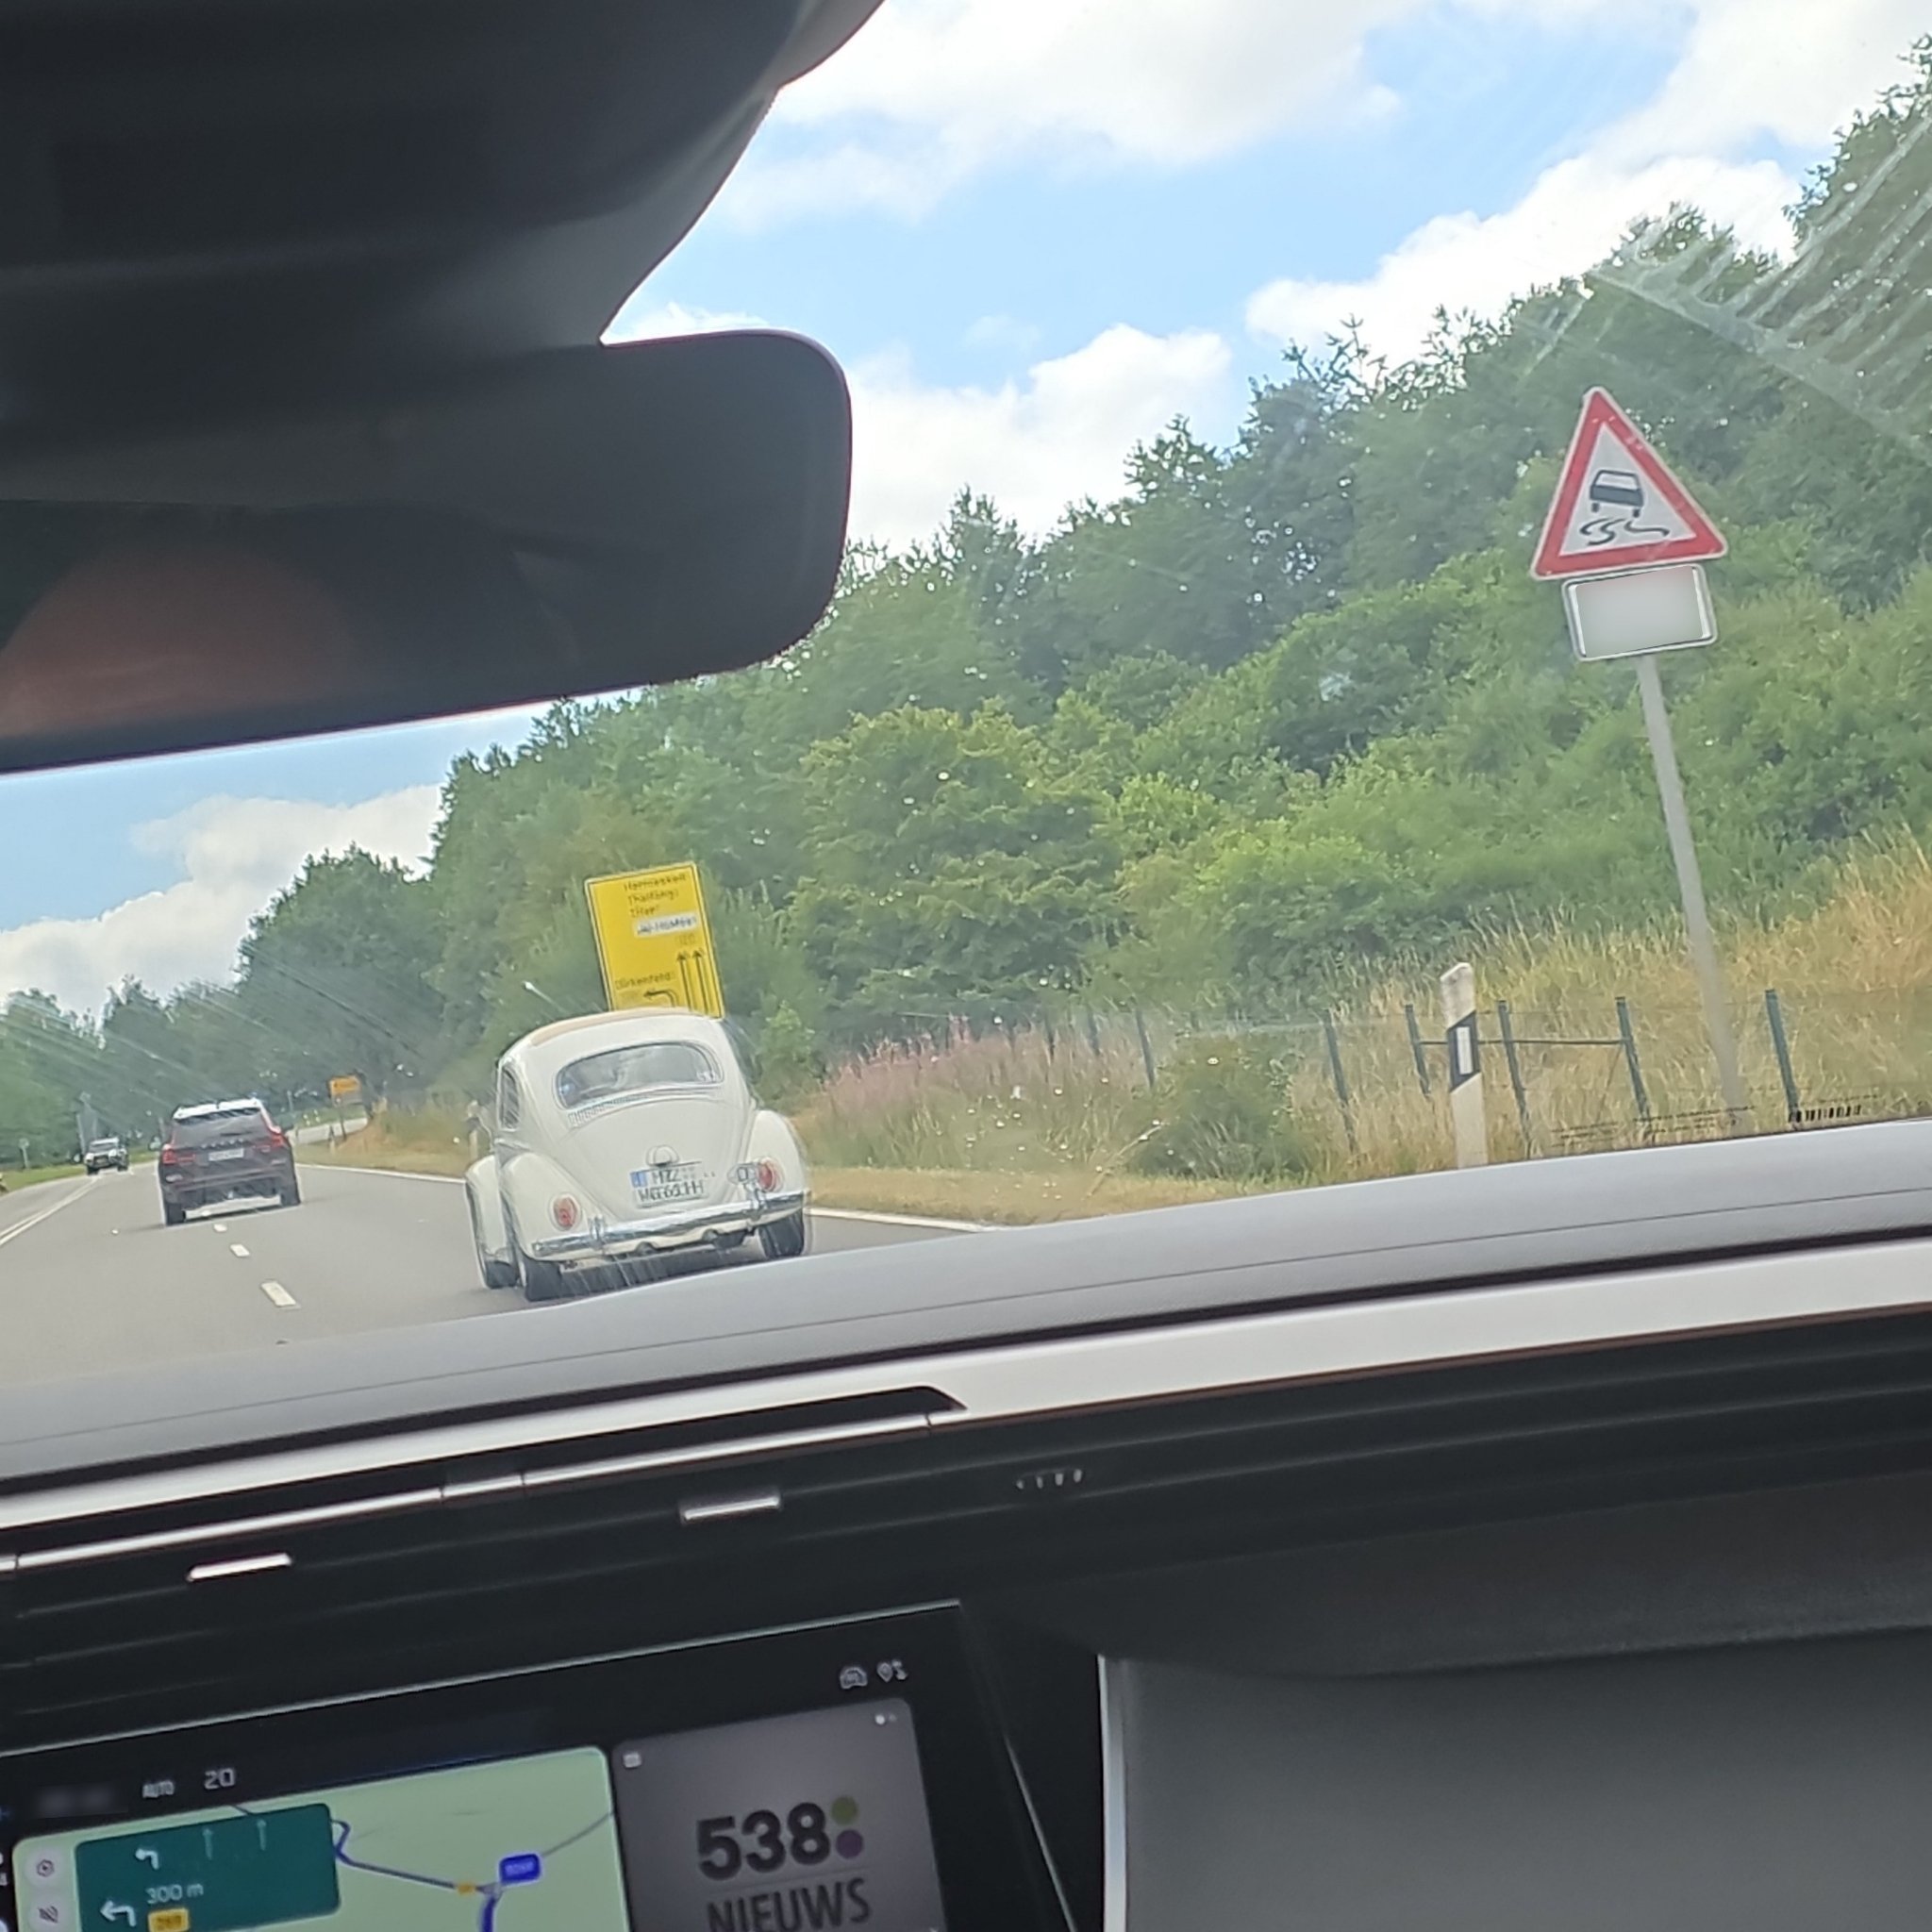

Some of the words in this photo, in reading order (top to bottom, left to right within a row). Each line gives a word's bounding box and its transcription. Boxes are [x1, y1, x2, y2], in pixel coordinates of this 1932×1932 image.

[204, 1769, 235, 1790] 20
[697, 1802, 830, 1880] 538
[145, 1885, 183, 1904] 300
[708, 1878, 871, 1931] NIEUWS
